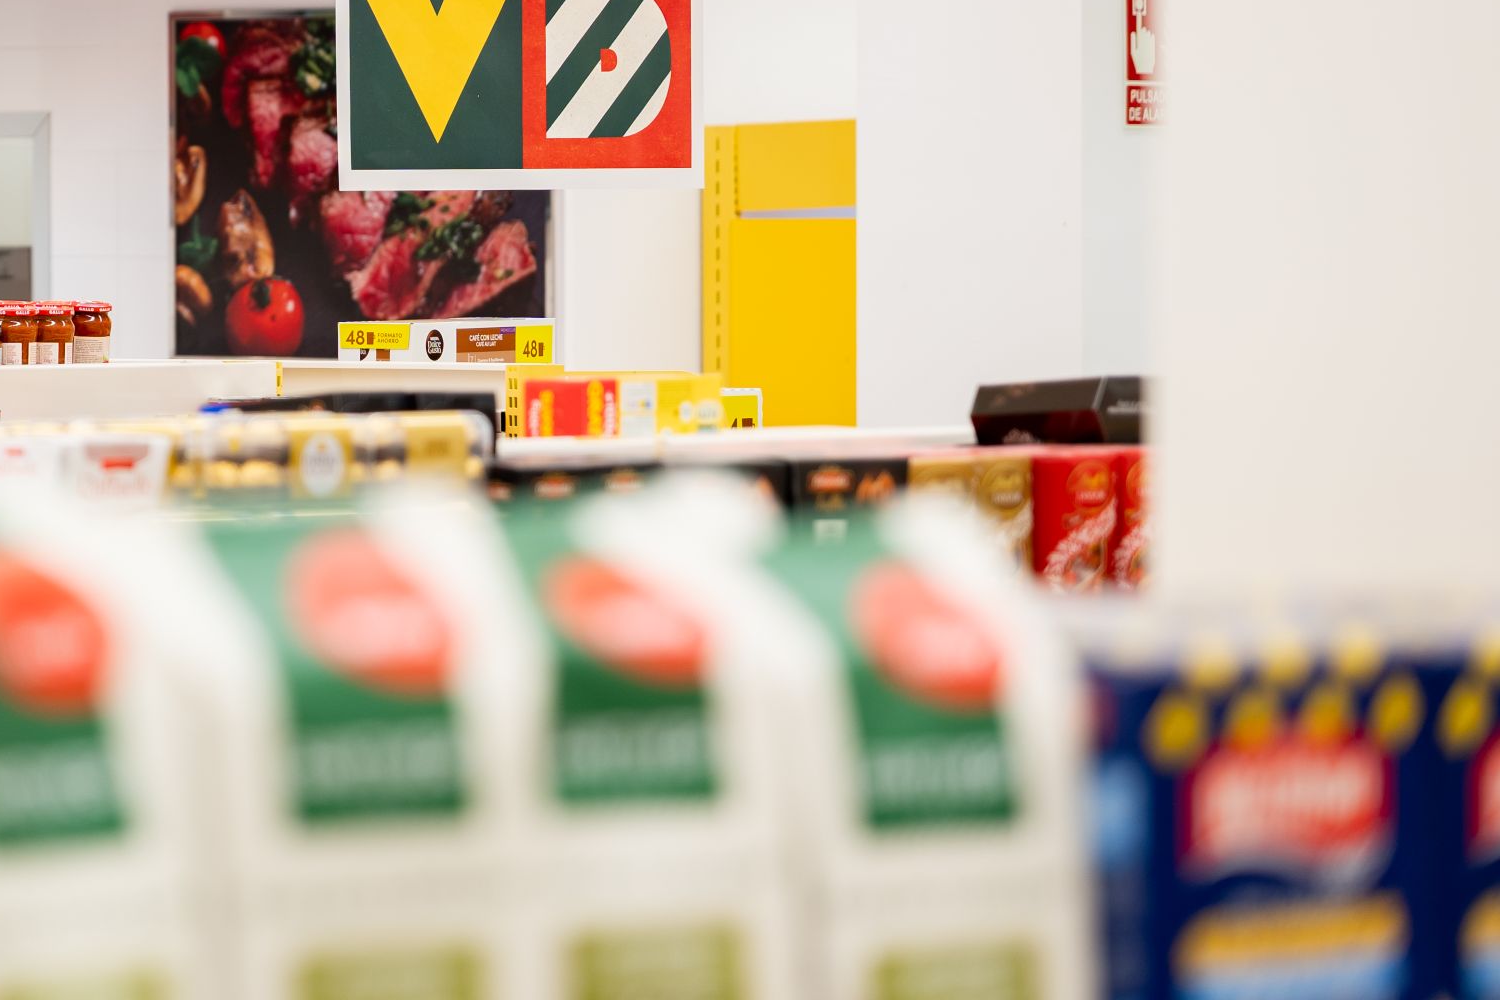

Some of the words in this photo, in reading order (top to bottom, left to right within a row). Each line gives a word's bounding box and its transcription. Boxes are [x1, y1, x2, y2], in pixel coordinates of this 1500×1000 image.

[1129, 106, 1142, 122] DE
[345, 329, 365, 345] 48
[522, 339, 538, 358] 48
